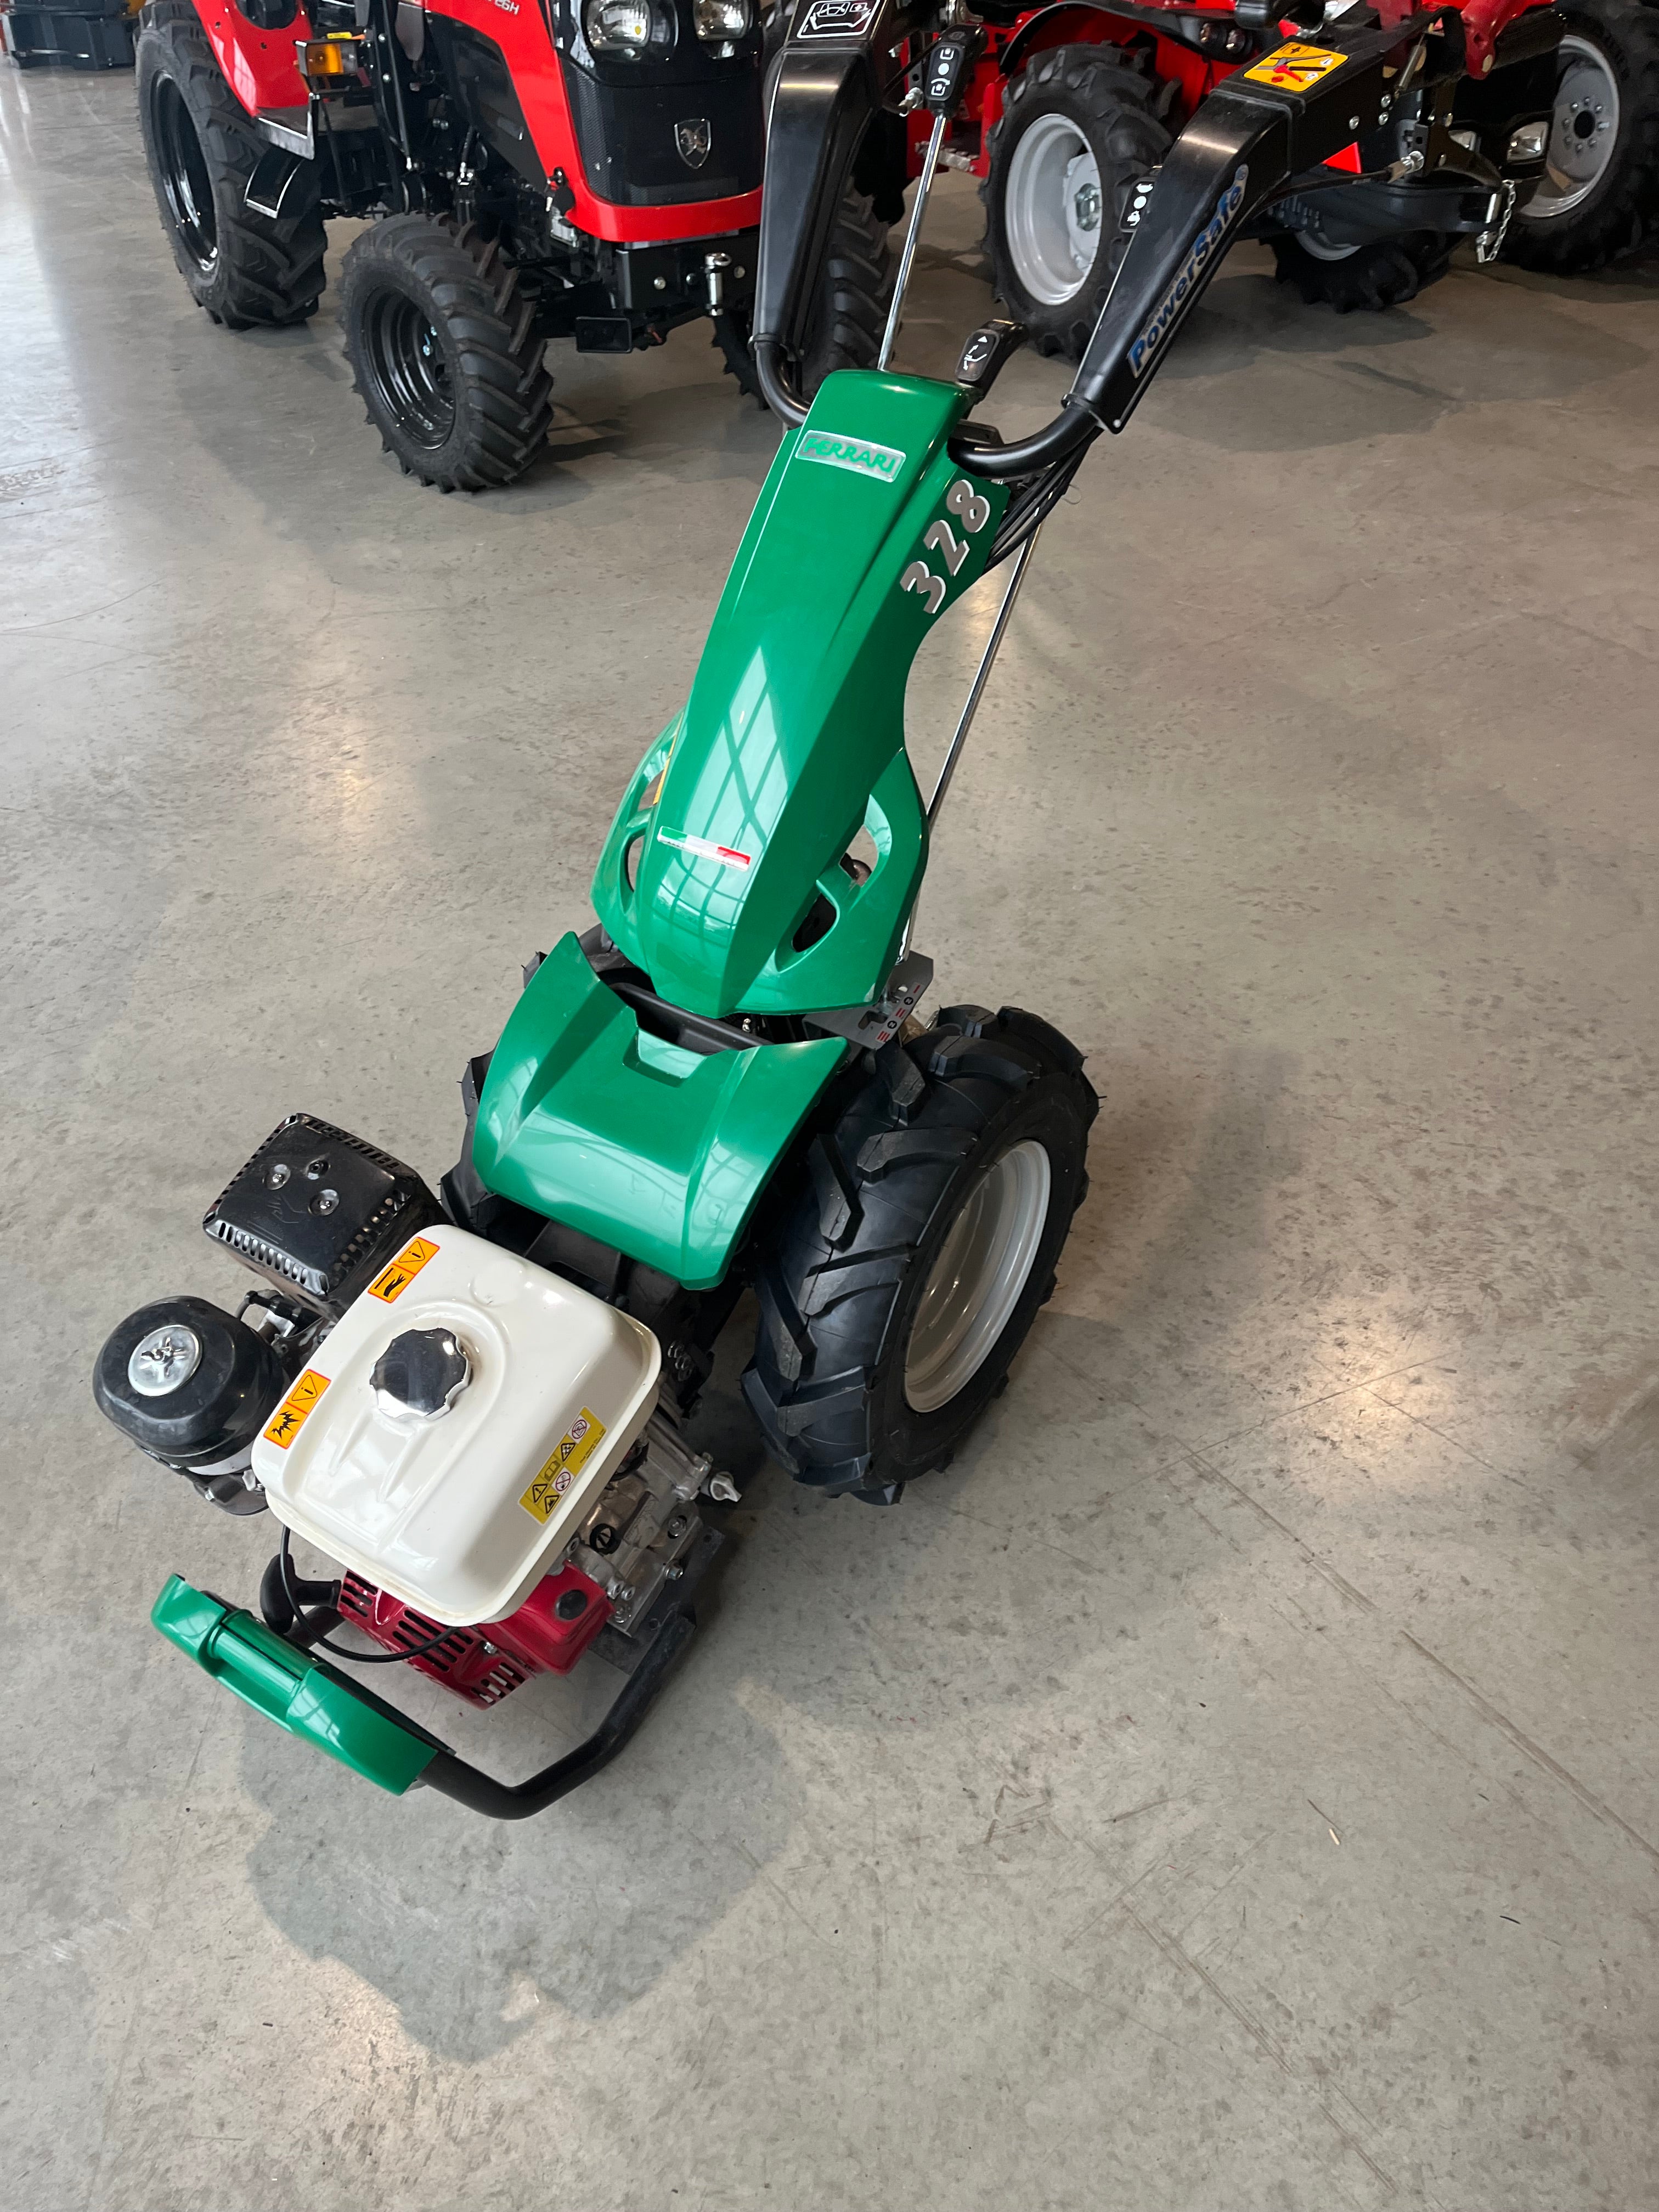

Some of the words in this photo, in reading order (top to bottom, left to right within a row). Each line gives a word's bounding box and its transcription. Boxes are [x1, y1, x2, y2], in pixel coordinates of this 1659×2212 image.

[1130, 185, 1242, 371] PowerSafe
[803, 437, 896, 473] FERRARI
[899, 479, 991, 614] 328
